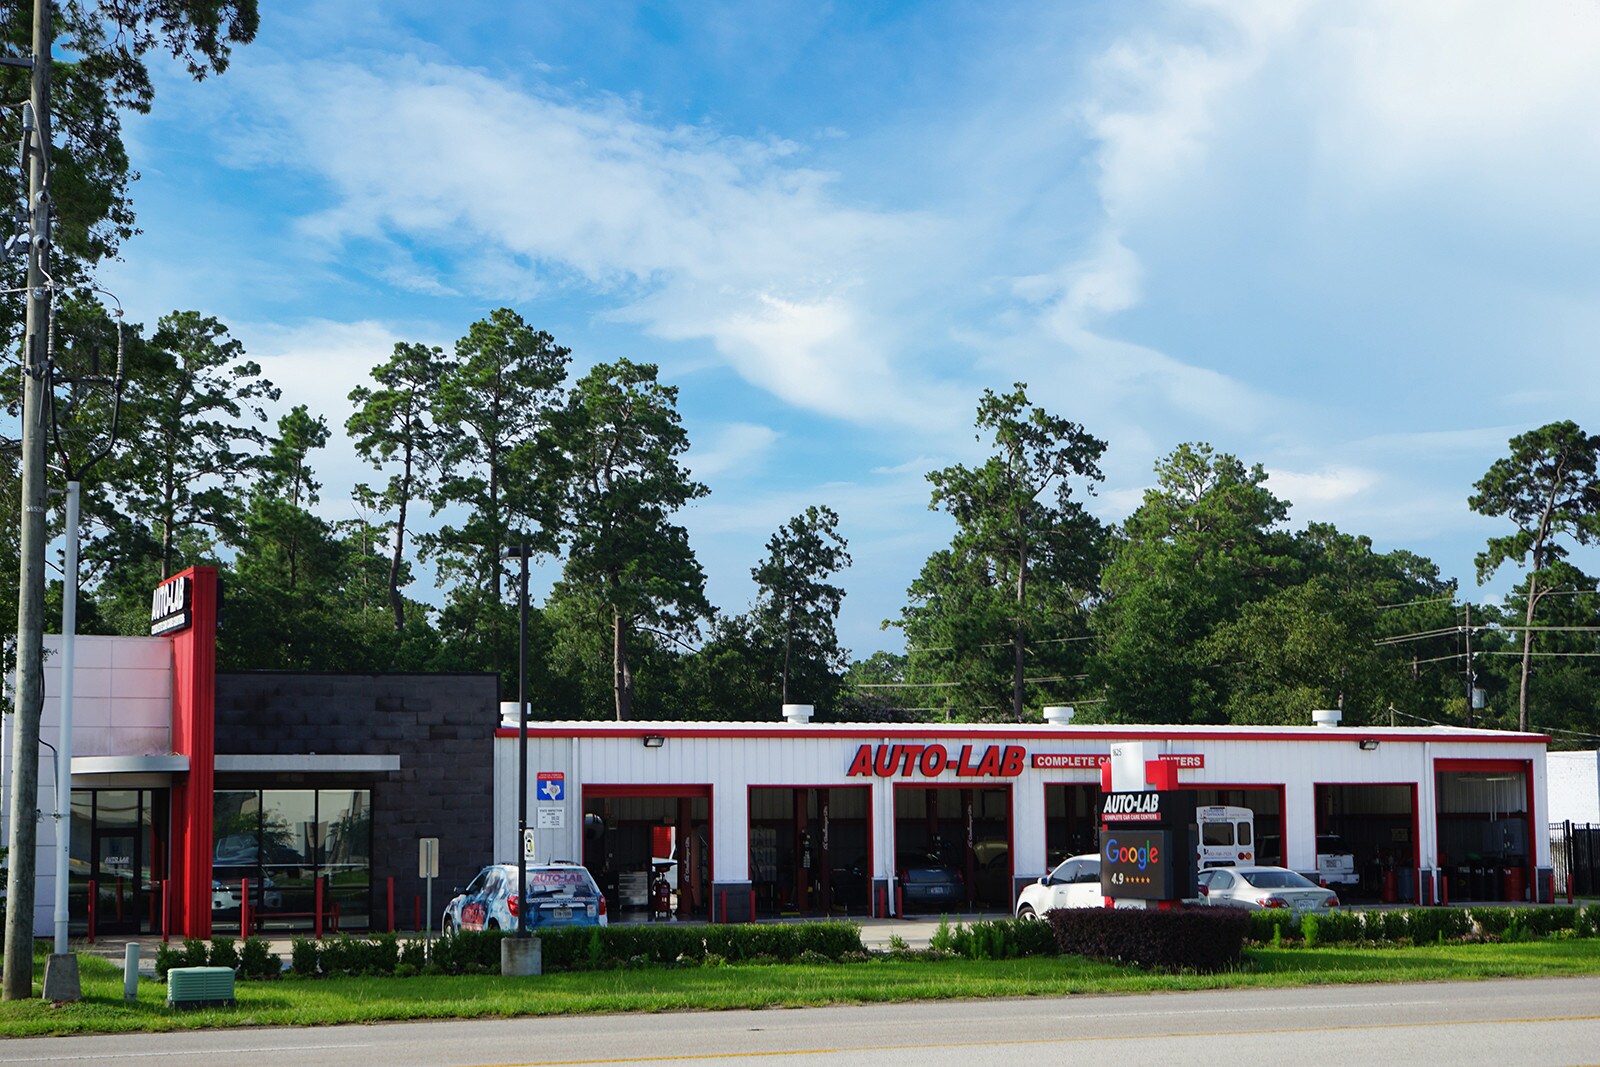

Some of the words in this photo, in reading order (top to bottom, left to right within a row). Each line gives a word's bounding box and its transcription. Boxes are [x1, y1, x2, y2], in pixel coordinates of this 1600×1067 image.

[151, 576, 185, 621] AUTO-LAB
[846, 744, 1026, 777] AUTO-LAB
[1037, 756, 1095, 766] COMPLETE
[1103, 794, 1160, 813] AUTO-LAB
[1105, 839, 1159, 870] Google
[532, 874, 583, 882] AUTO-LAB
[1111, 873, 1124, 884] 4.9
